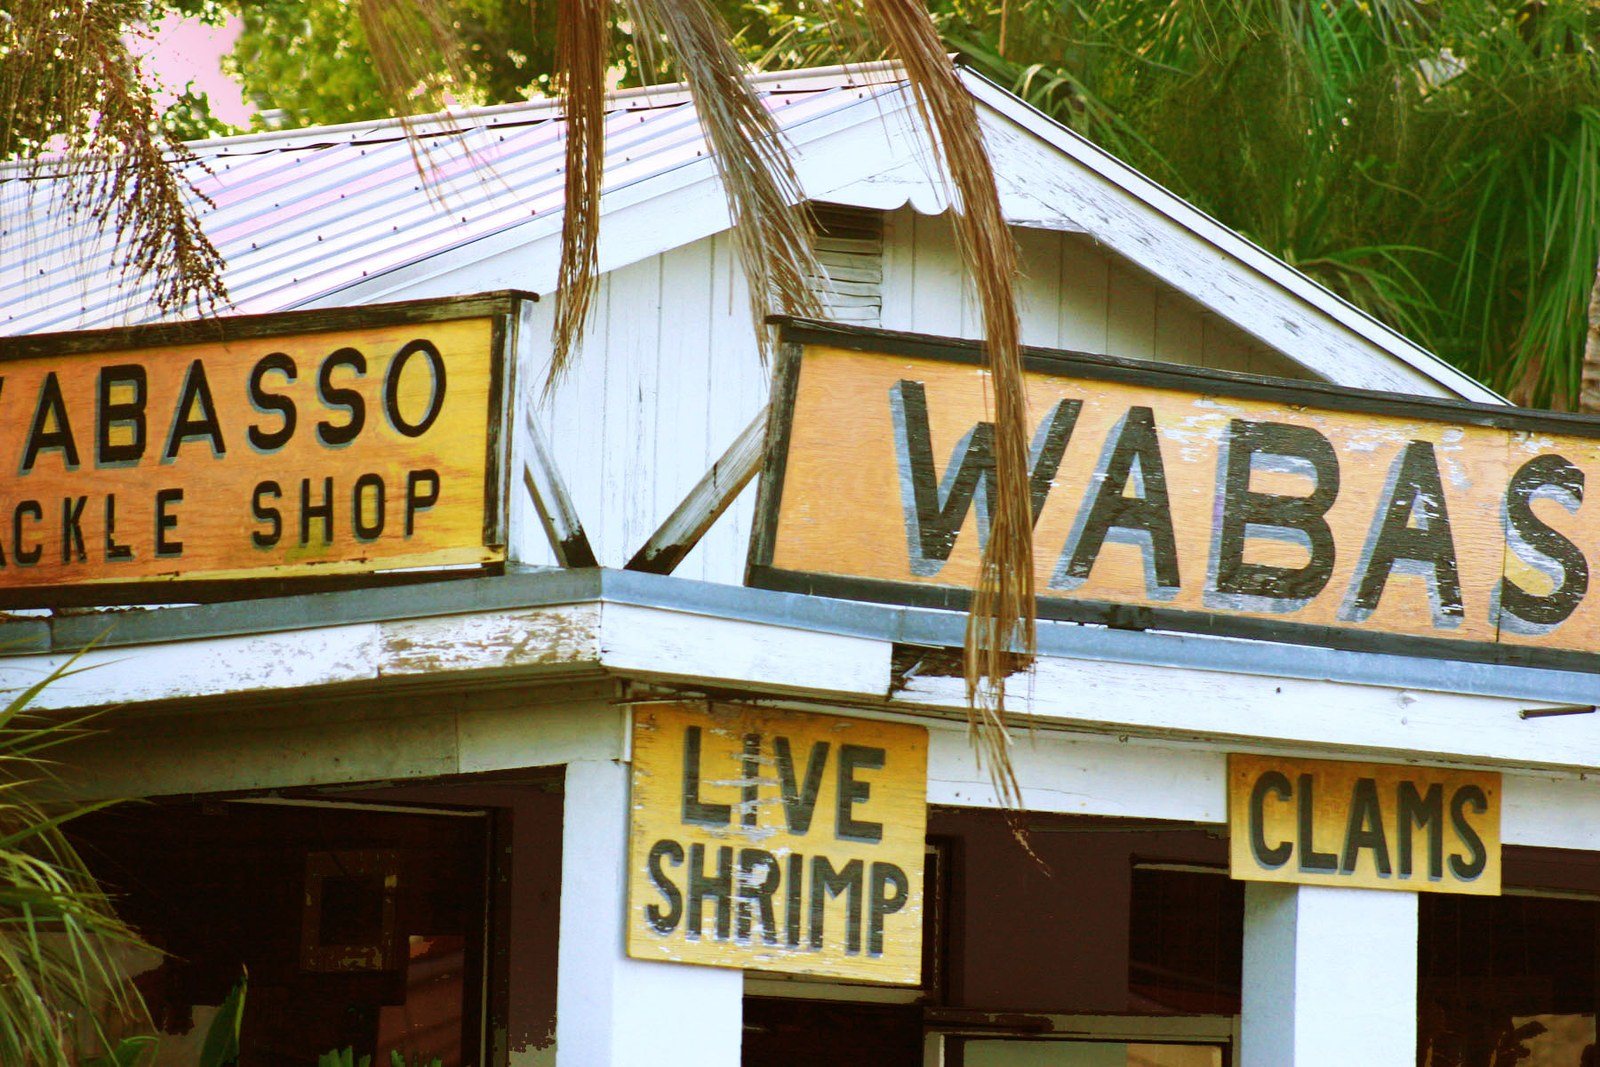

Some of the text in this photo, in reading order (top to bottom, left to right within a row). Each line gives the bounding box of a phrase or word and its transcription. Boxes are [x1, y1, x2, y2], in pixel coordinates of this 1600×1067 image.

[0, 338, 447, 475] ABASSO
[0, 469, 440, 568] CKLE SHOP
[888, 378, 1589, 637] WABAS
[681, 725, 886, 844] LIVE
[1250, 770, 1488, 882] CLAMS
[645, 838, 909, 958] SHRIMP
